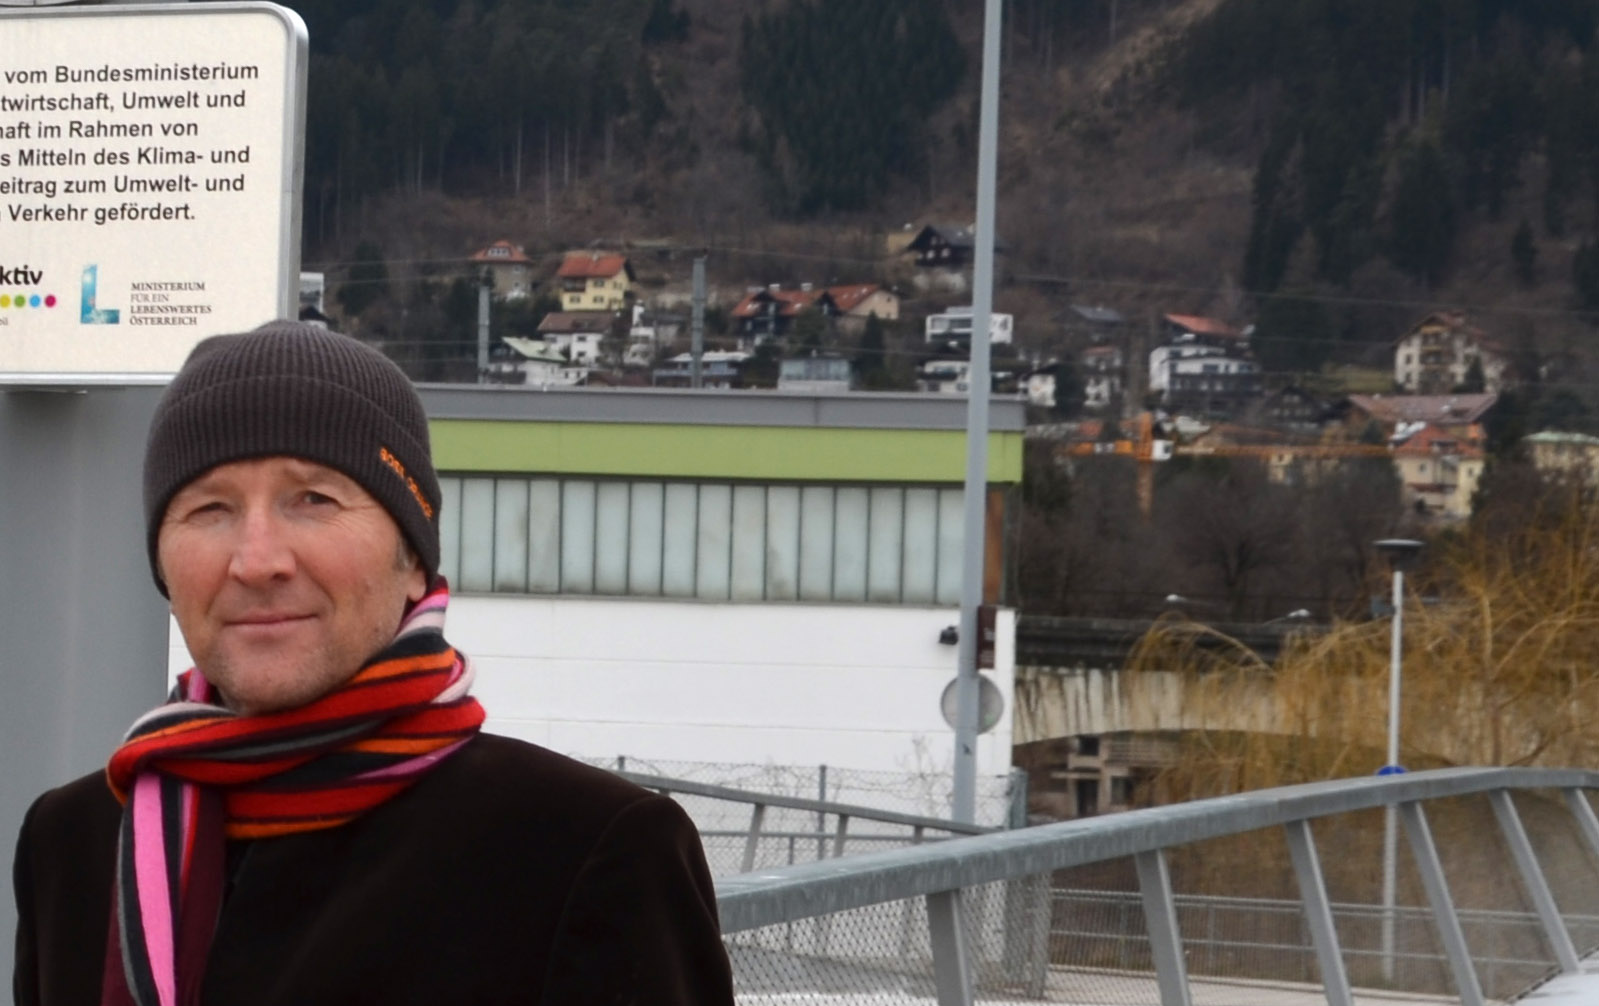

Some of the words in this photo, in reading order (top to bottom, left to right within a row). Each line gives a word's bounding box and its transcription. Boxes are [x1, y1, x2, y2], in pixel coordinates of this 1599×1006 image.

[4, 70, 48, 84] vom
[55, 62, 259, 83] Bundesministerium
[122, 90, 199, 110] Umwelt
[206, 89, 246, 108] und
[37, 121, 61, 139] im
[69, 120, 153, 138] Rahmen
[160, 122, 198, 137] von
[18, 148, 86, 167] Mitteln
[93, 147, 130, 166] des
[137, 146, 204, 165] Klima-
[210, 145, 250, 164] und
[63, 179, 106, 194] zum
[114, 174, 198, 193] Umwelt-
[205, 173, 245, 192] und
[7, 203, 89, 222] Verkehr
[94, 202, 195, 226] gefördert.
[130, 281, 206, 291] MINISTERIUM
[130, 304, 212, 314] LEBENSWERTES
[129, 315, 198, 326] ÖSTERREICH
